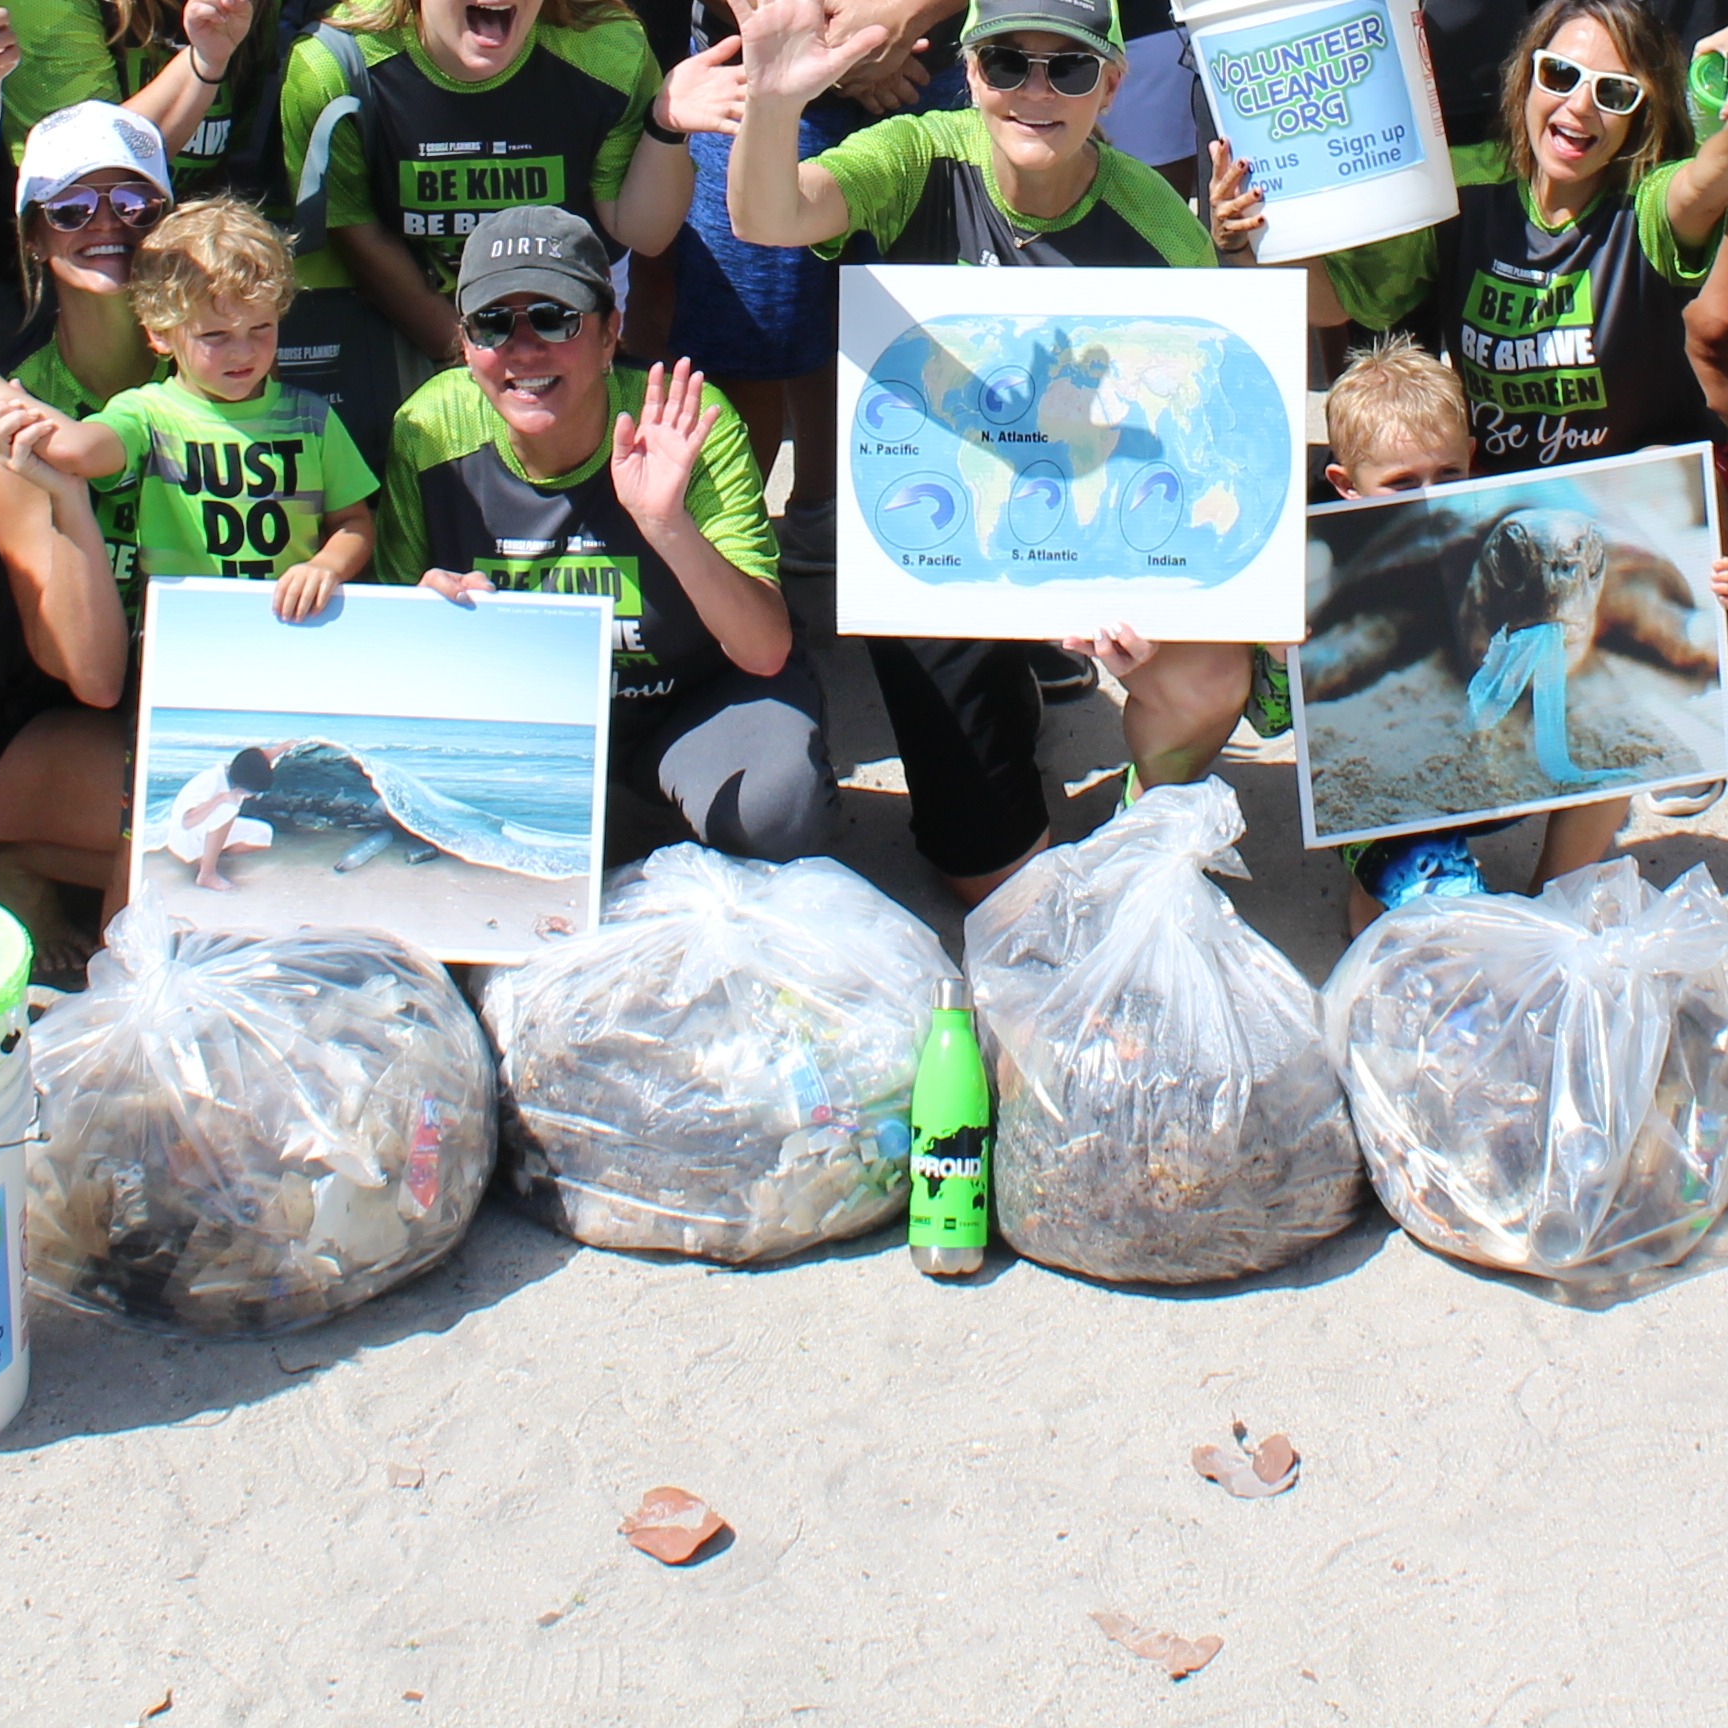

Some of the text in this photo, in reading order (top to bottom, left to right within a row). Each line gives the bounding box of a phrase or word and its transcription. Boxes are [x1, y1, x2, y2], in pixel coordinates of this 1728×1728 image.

[1213, 16, 1386, 90] VOLUNTEER
[1235, 53, 1370, 115] CLEANUP
[1272, 92, 1348, 139] .ORG
[1327, 123, 1406, 159] Sign up
[1248, 152, 1300, 175] oin us
[1338, 146, 1402, 177] online
[417, 166, 549, 203] BE KIND
[1249, 176, 1283, 195] now
[404, 212, 445, 236] BE
[1478, 284, 1516, 326] BE
[276, 347, 303, 360] RUISE
[1461, 324, 1596, 371] BE BRAVE
[1501, 375, 1601, 408] GREEN
[981, 430, 1049, 444] N. Atlantic
[1471, 400, 1608, 464] Be You
[859, 443, 920, 456] N. Pacific
[180, 439, 304, 499] JUST
[201, 500, 291, 557] DO
[902, 554, 962, 567] S. Pacific
[1011, 549, 1079, 562] S. Atlantic
[1147, 554, 1187, 567] Indian
[541, 566, 622, 603] KIND
